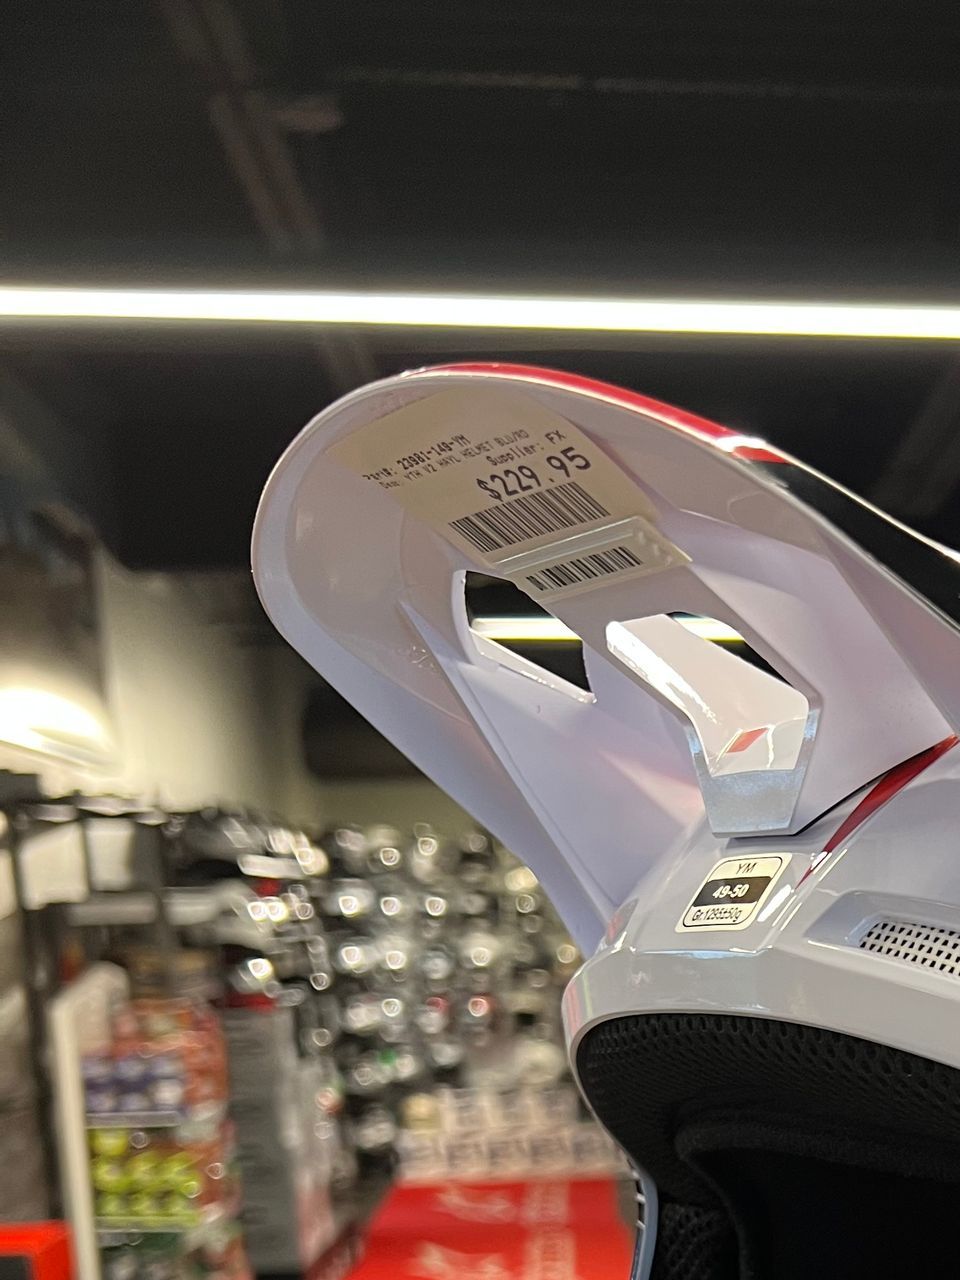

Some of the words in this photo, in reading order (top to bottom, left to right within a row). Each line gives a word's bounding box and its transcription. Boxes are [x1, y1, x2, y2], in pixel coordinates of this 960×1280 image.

[423, 463, 437, 474] V2
[461, 441, 494, 458] HELMET
[486, 443, 544, 466] Supplier:
[545, 430, 566, 445] FX
[476, 447, 591, 501] $229.95
[736, 862, 757, 874] YM
[712, 884, 749, 898] 49-50
